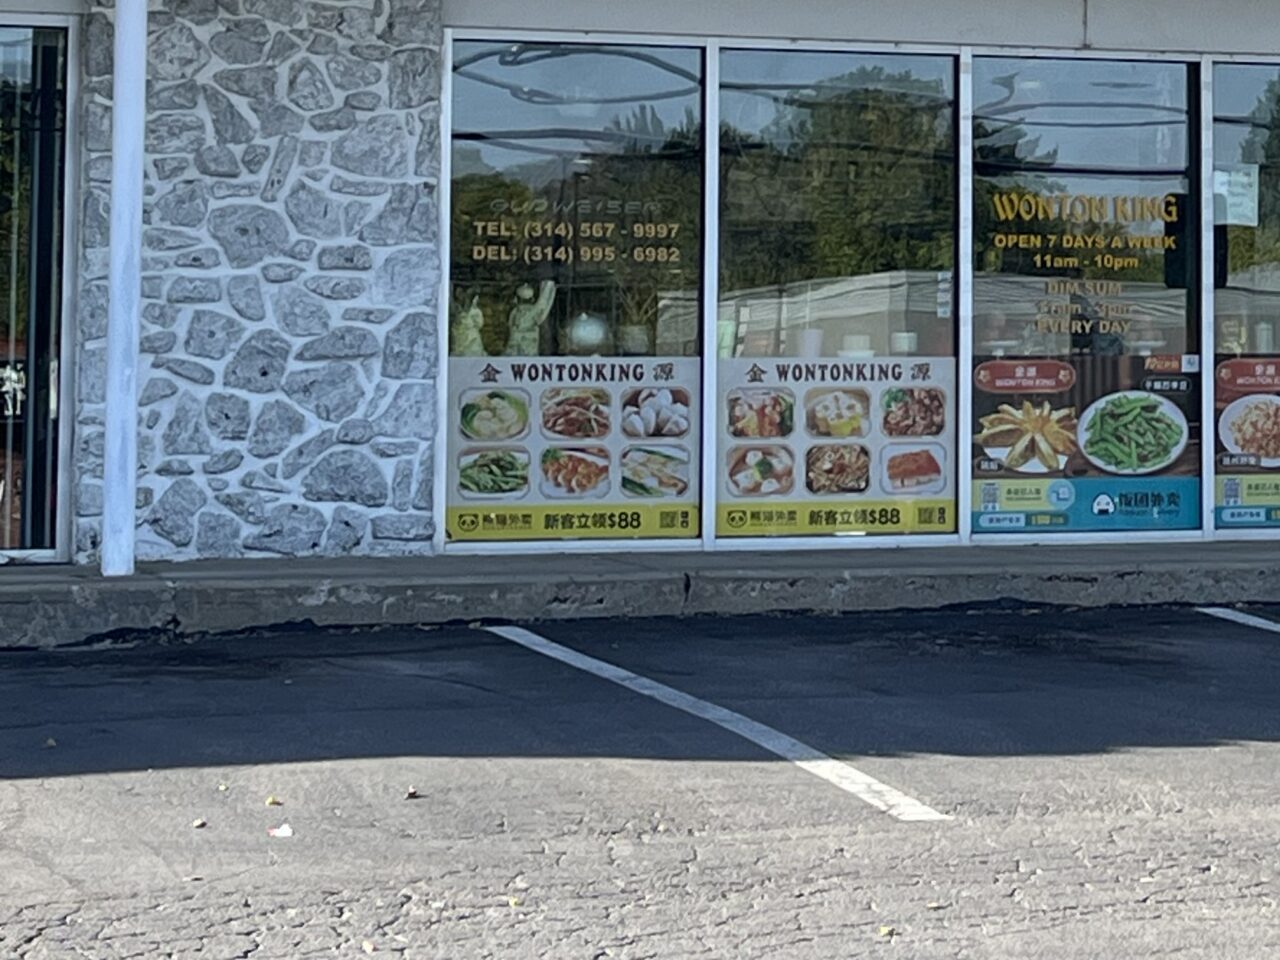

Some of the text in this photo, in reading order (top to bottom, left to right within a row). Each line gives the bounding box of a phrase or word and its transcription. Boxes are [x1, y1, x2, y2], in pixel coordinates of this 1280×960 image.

[993, 192, 1178, 224] WONTON KING
[473, 221, 518, 237] TEL:
[524, 221, 574, 240] (314)
[580, 222, 615, 238] 567
[633, 223, 680, 238] 9997
[994, 234, 1177, 249] OPEN 7 DAYS A WEEK
[472, 246, 518, 261] DEL:
[524, 246, 574, 264] (314)
[580, 247, 615, 262] 995
[633, 247, 680, 262] 6982
[1033, 254, 1079, 268] 11am
[1094, 254, 1140, 270] 10pm
[510, 363, 645, 383] WONTONKING
[775, 363, 903, 382] WONTONKING
